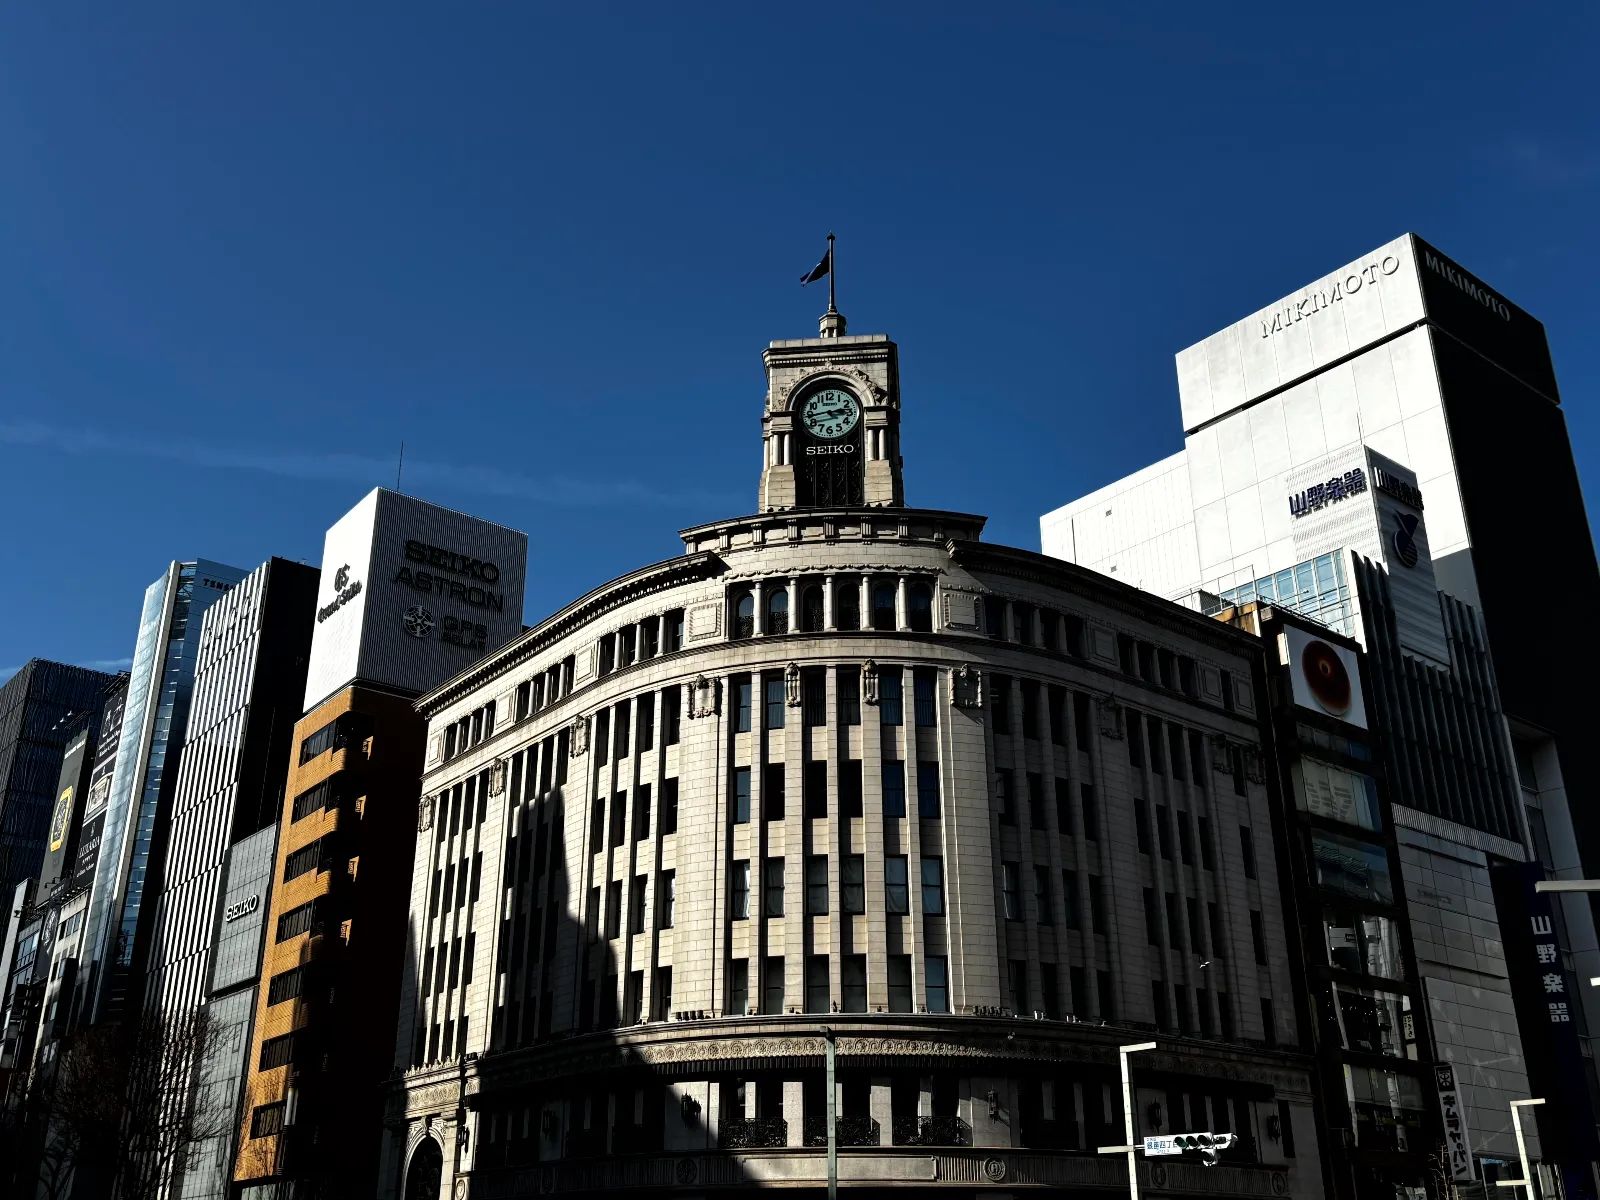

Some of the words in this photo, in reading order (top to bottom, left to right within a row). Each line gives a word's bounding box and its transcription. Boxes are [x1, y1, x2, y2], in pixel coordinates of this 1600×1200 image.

[1425, 250, 1511, 322] MIKIMOTO
[1260, 256, 1400, 339] MIKIMOTO
[817, 395, 824, 404] 11
[826, 392, 834, 401] 12
[837, 394, 841, 403] 1
[810, 402, 817, 410] 10
[843, 399, 850, 408] 2
[809, 418, 817, 427] 8
[843, 417, 851, 425] 4
[817, 424, 825, 433] 7
[826, 425, 834, 434] 6
[835, 423, 843, 432] 5
[806, 444, 854, 455] SEIKO
[1288, 467, 1364, 516] 山野楽器
[405, 540, 500, 584] SEIKO
[394, 567, 504, 612] ASTRON
[225, 894, 259, 922] SEIKO
[1530, 914, 1571, 1024] 山野楽器
